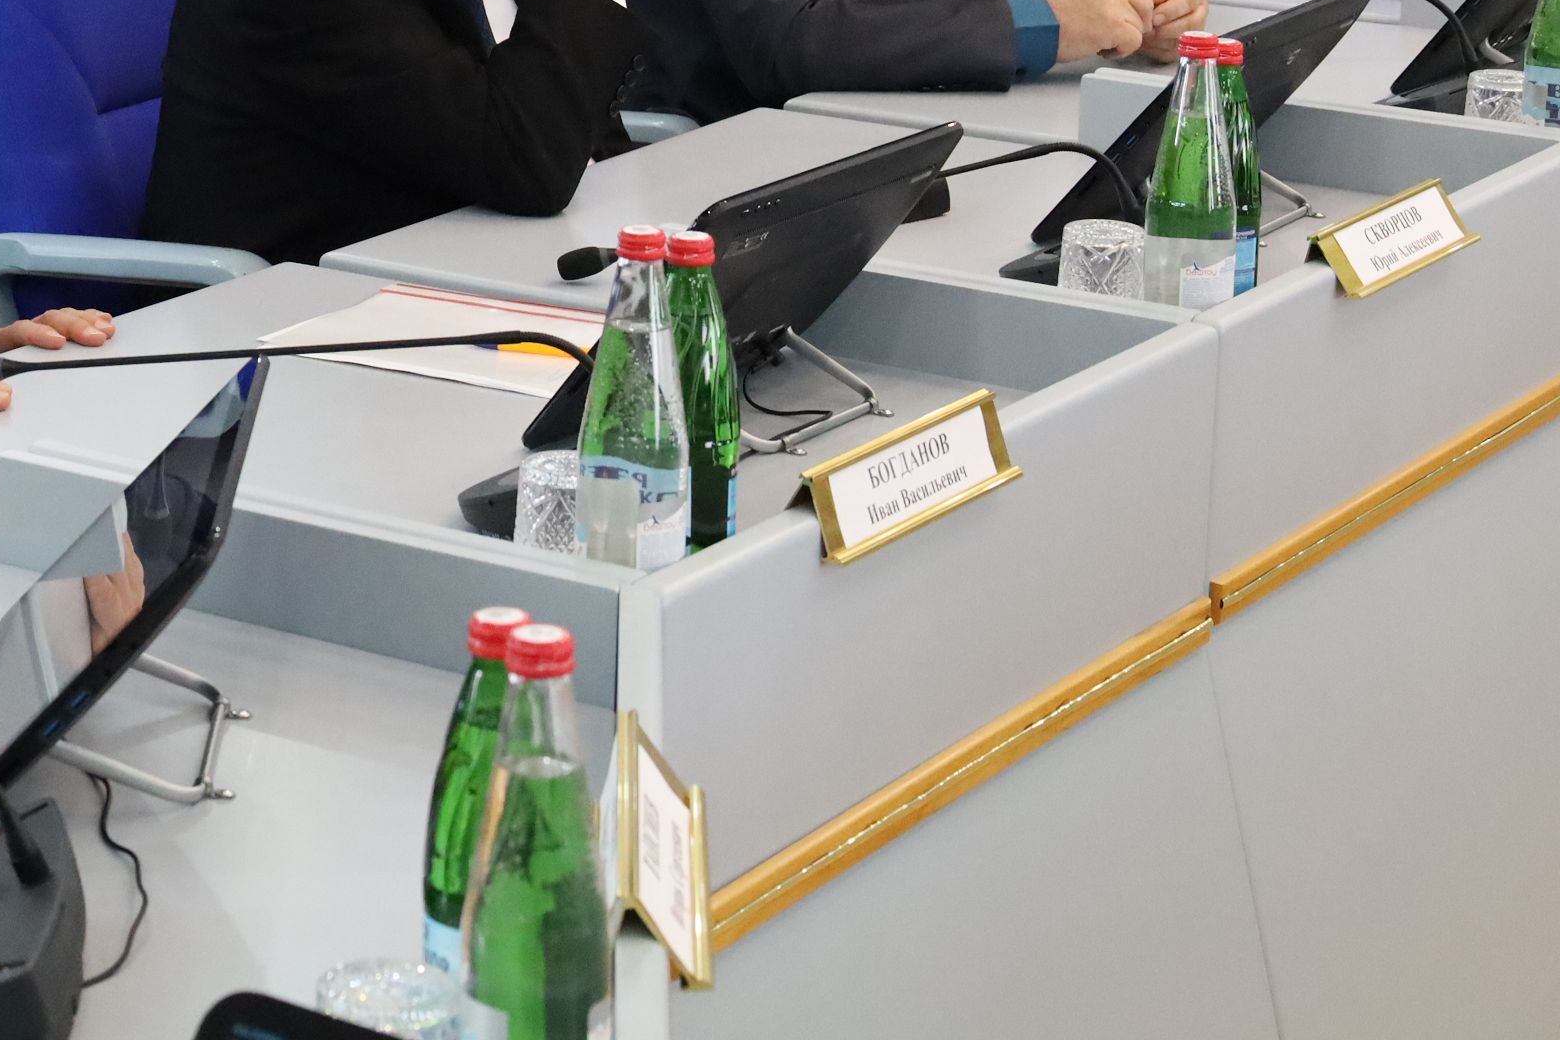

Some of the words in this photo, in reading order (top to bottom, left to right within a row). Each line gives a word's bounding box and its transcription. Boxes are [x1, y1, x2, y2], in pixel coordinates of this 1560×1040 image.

[1363, 205, 1423, 246] СКВОРЦОВ
[1369, 247, 1399, 272] Юрий
[1399, 228, 1445, 259] Алексеевич
[866, 432, 951, 490] БОГДАНОВ
[866, 499, 901, 525] Иван
[900, 464, 969, 514] Васильевич
